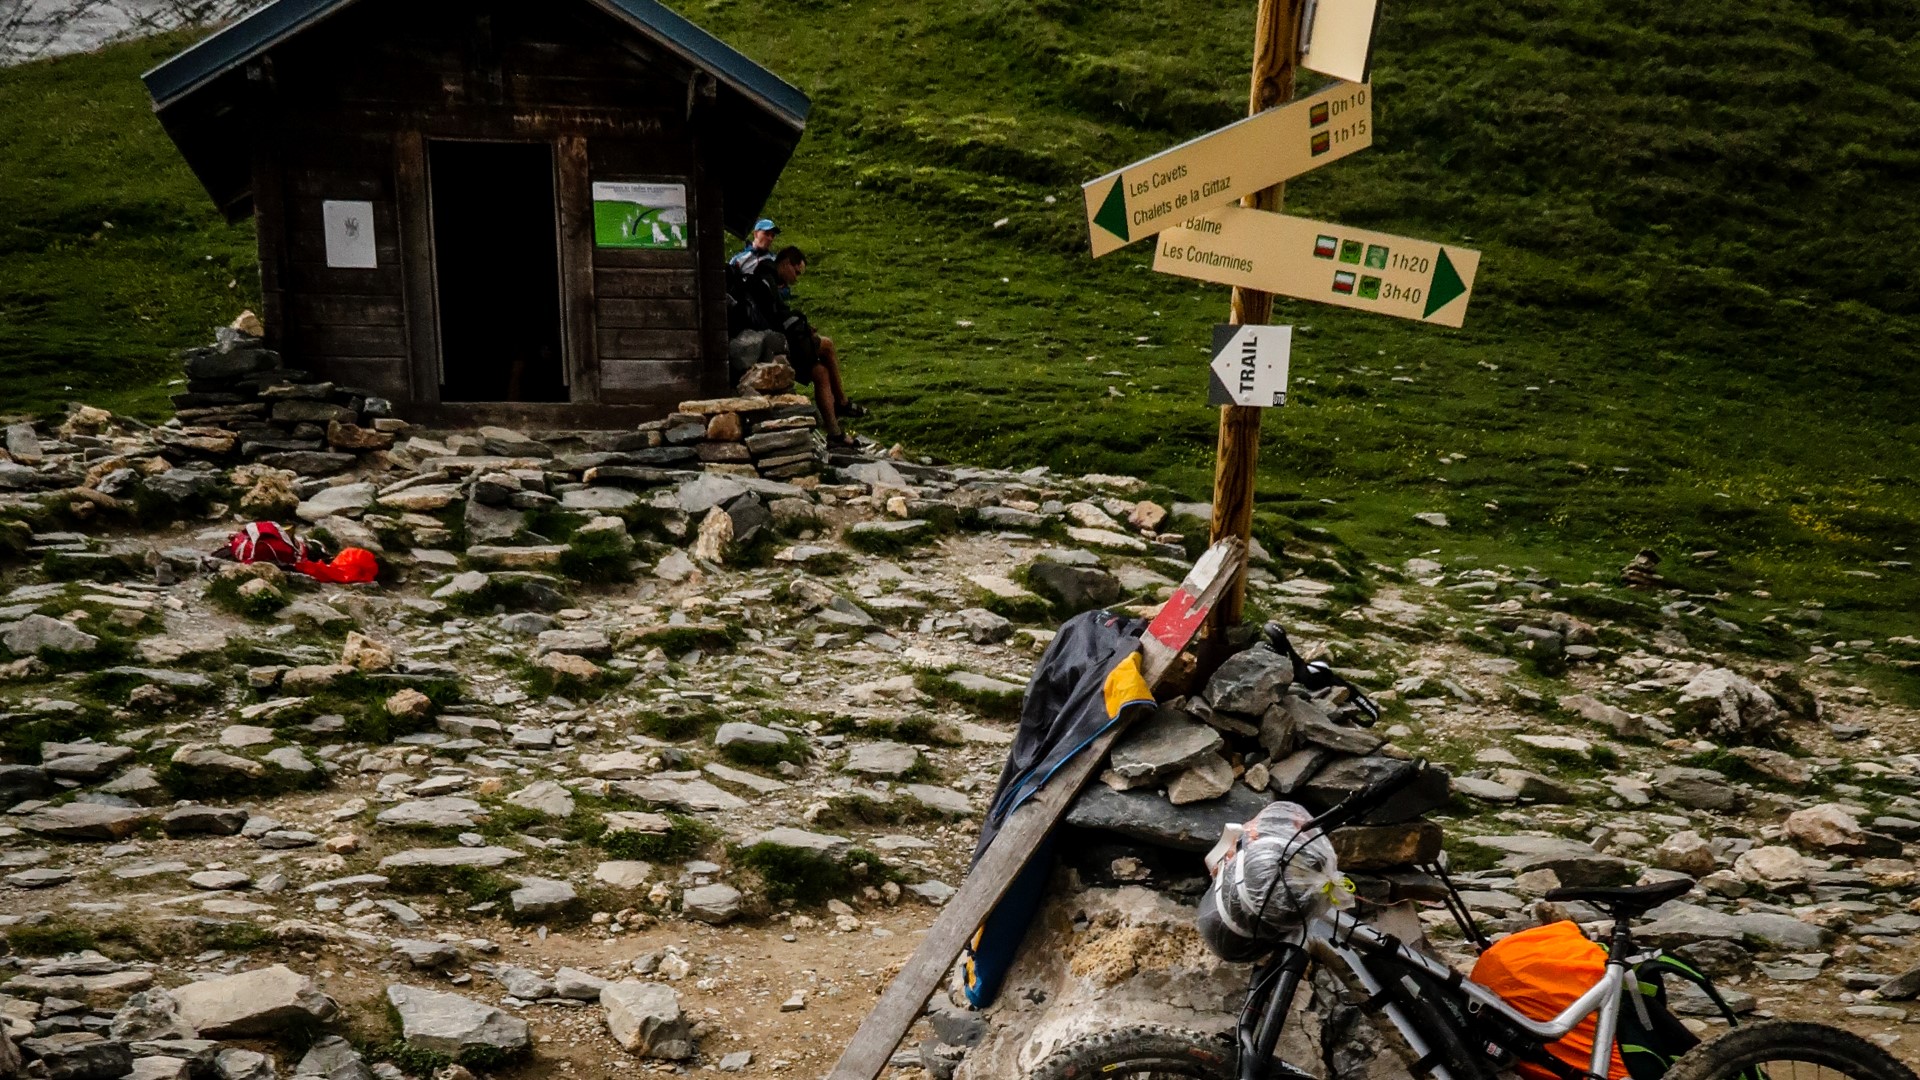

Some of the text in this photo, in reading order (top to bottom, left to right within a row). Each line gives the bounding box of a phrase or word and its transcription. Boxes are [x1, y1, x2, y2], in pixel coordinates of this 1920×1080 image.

[1332, 90, 1365, 116] 0h10
[1334, 119, 1366, 143] 1h15
[1129, 164, 1188, 198] Les Cavets
[1133, 176, 1231, 226] Chalets de la Gittaz
[1186, 216, 1222, 235] Balme
[1162, 241, 1254, 273] Les Contamines
[1391, 252, 1429, 274] 1h20
[1382, 283, 1421, 304] 3h40
[1239, 336, 1258, 394] TRAIL
